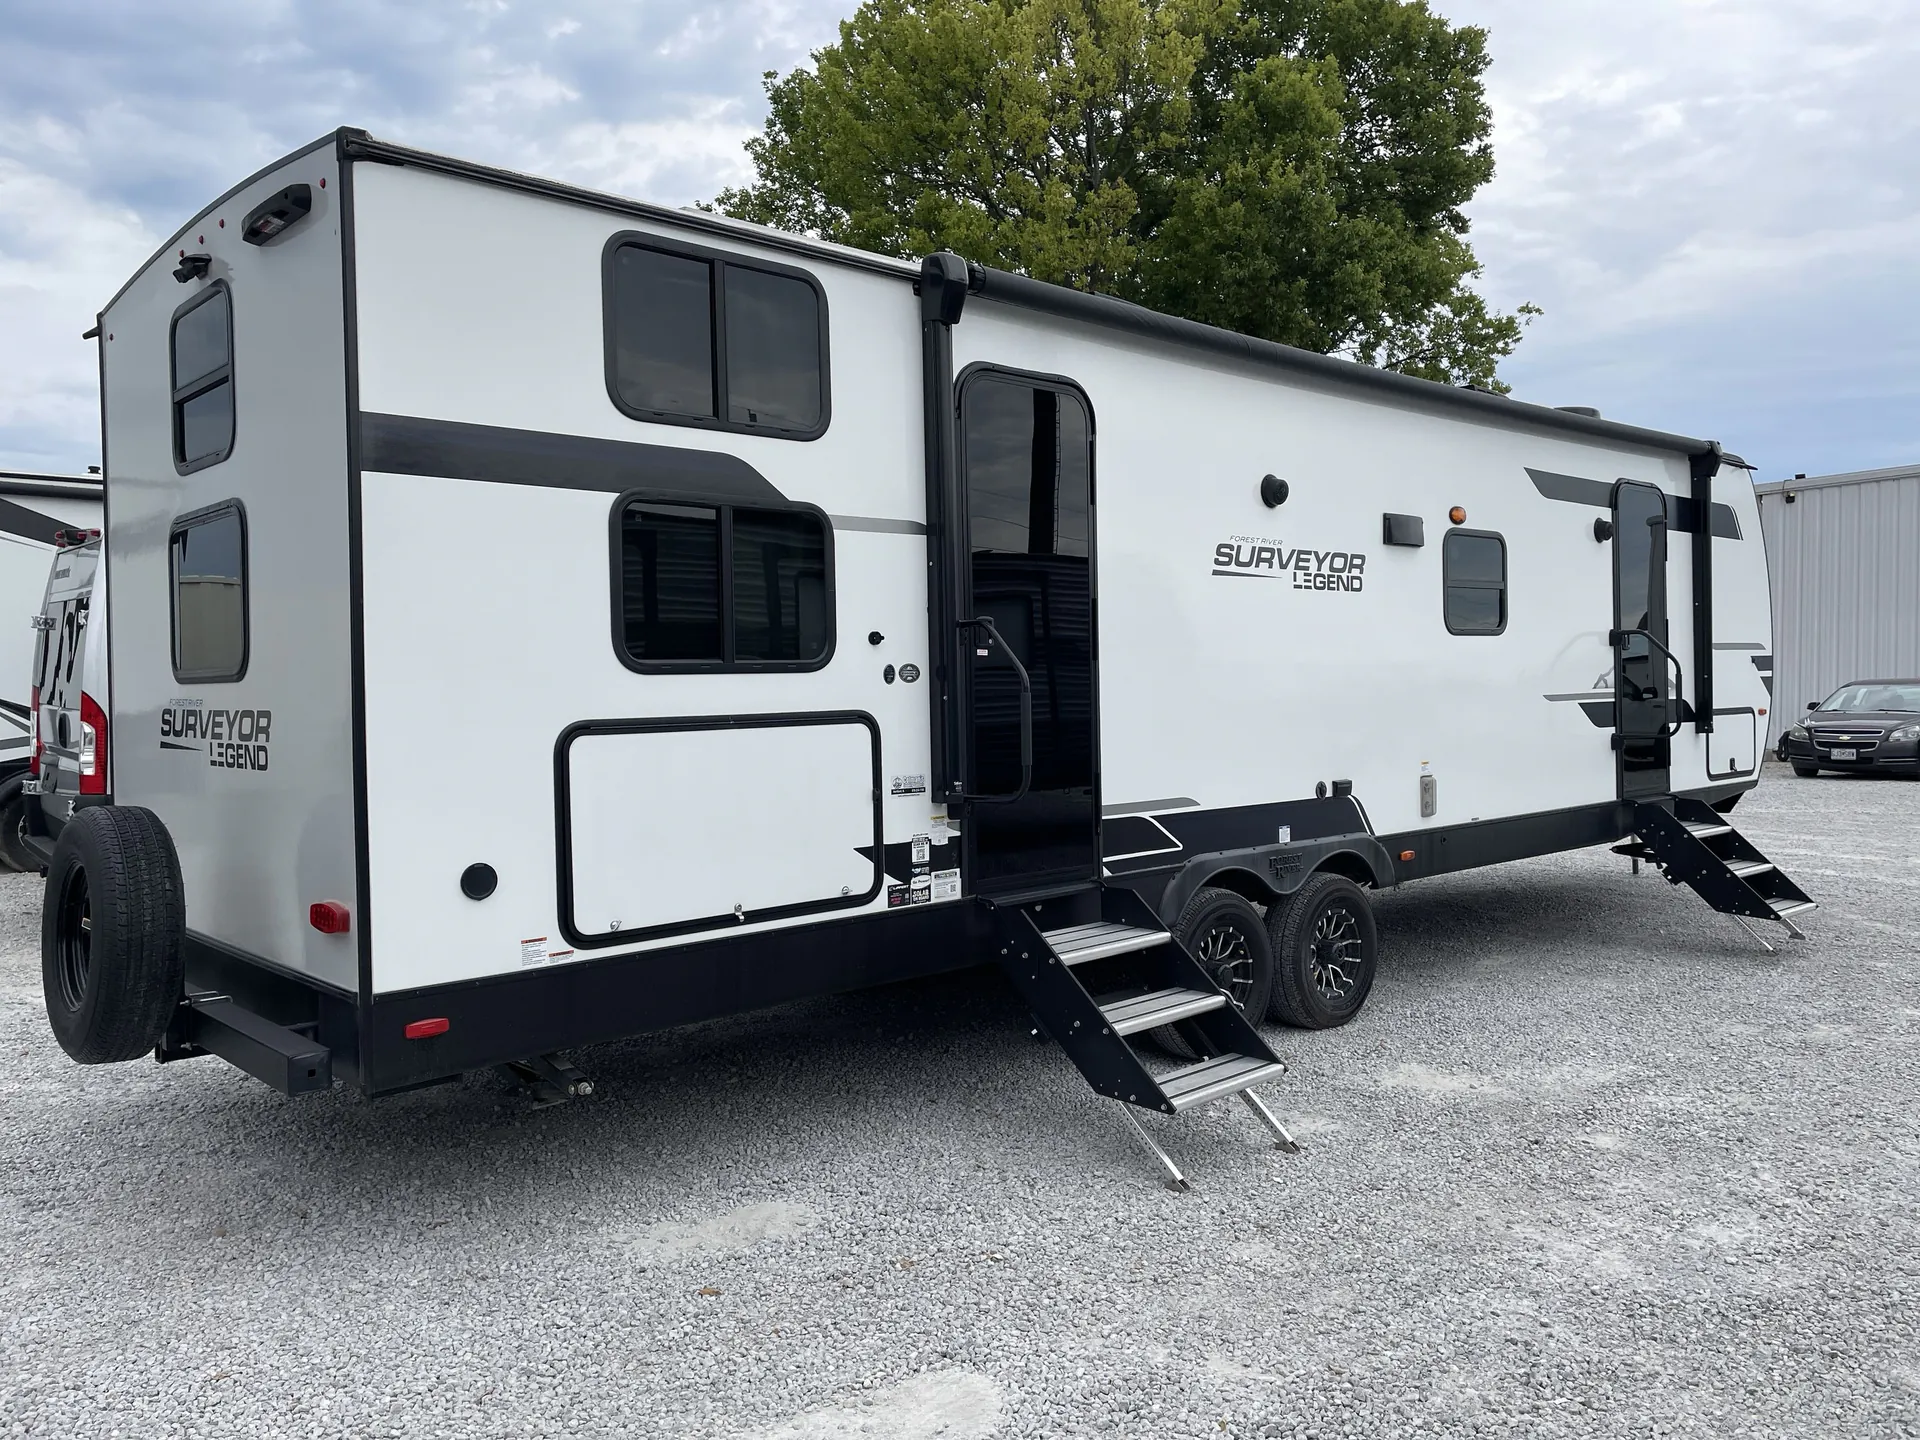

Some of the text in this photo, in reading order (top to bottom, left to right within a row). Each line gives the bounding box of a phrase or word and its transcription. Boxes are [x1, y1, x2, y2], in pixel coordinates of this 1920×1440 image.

[1230, 535, 1284, 546] FOREST RIVER
[1213, 543, 1366, 574] SURVEYOR
[1293, 571, 1363, 592] LEGEND
[170, 699, 204, 708] FOREST RIVER
[160, 708, 272, 742] SURVEYOR
[209, 742, 269, 771] LEGEND
[1269, 852, 1303, 870] FOREST
[1275, 863, 1301, 879] RIVER
